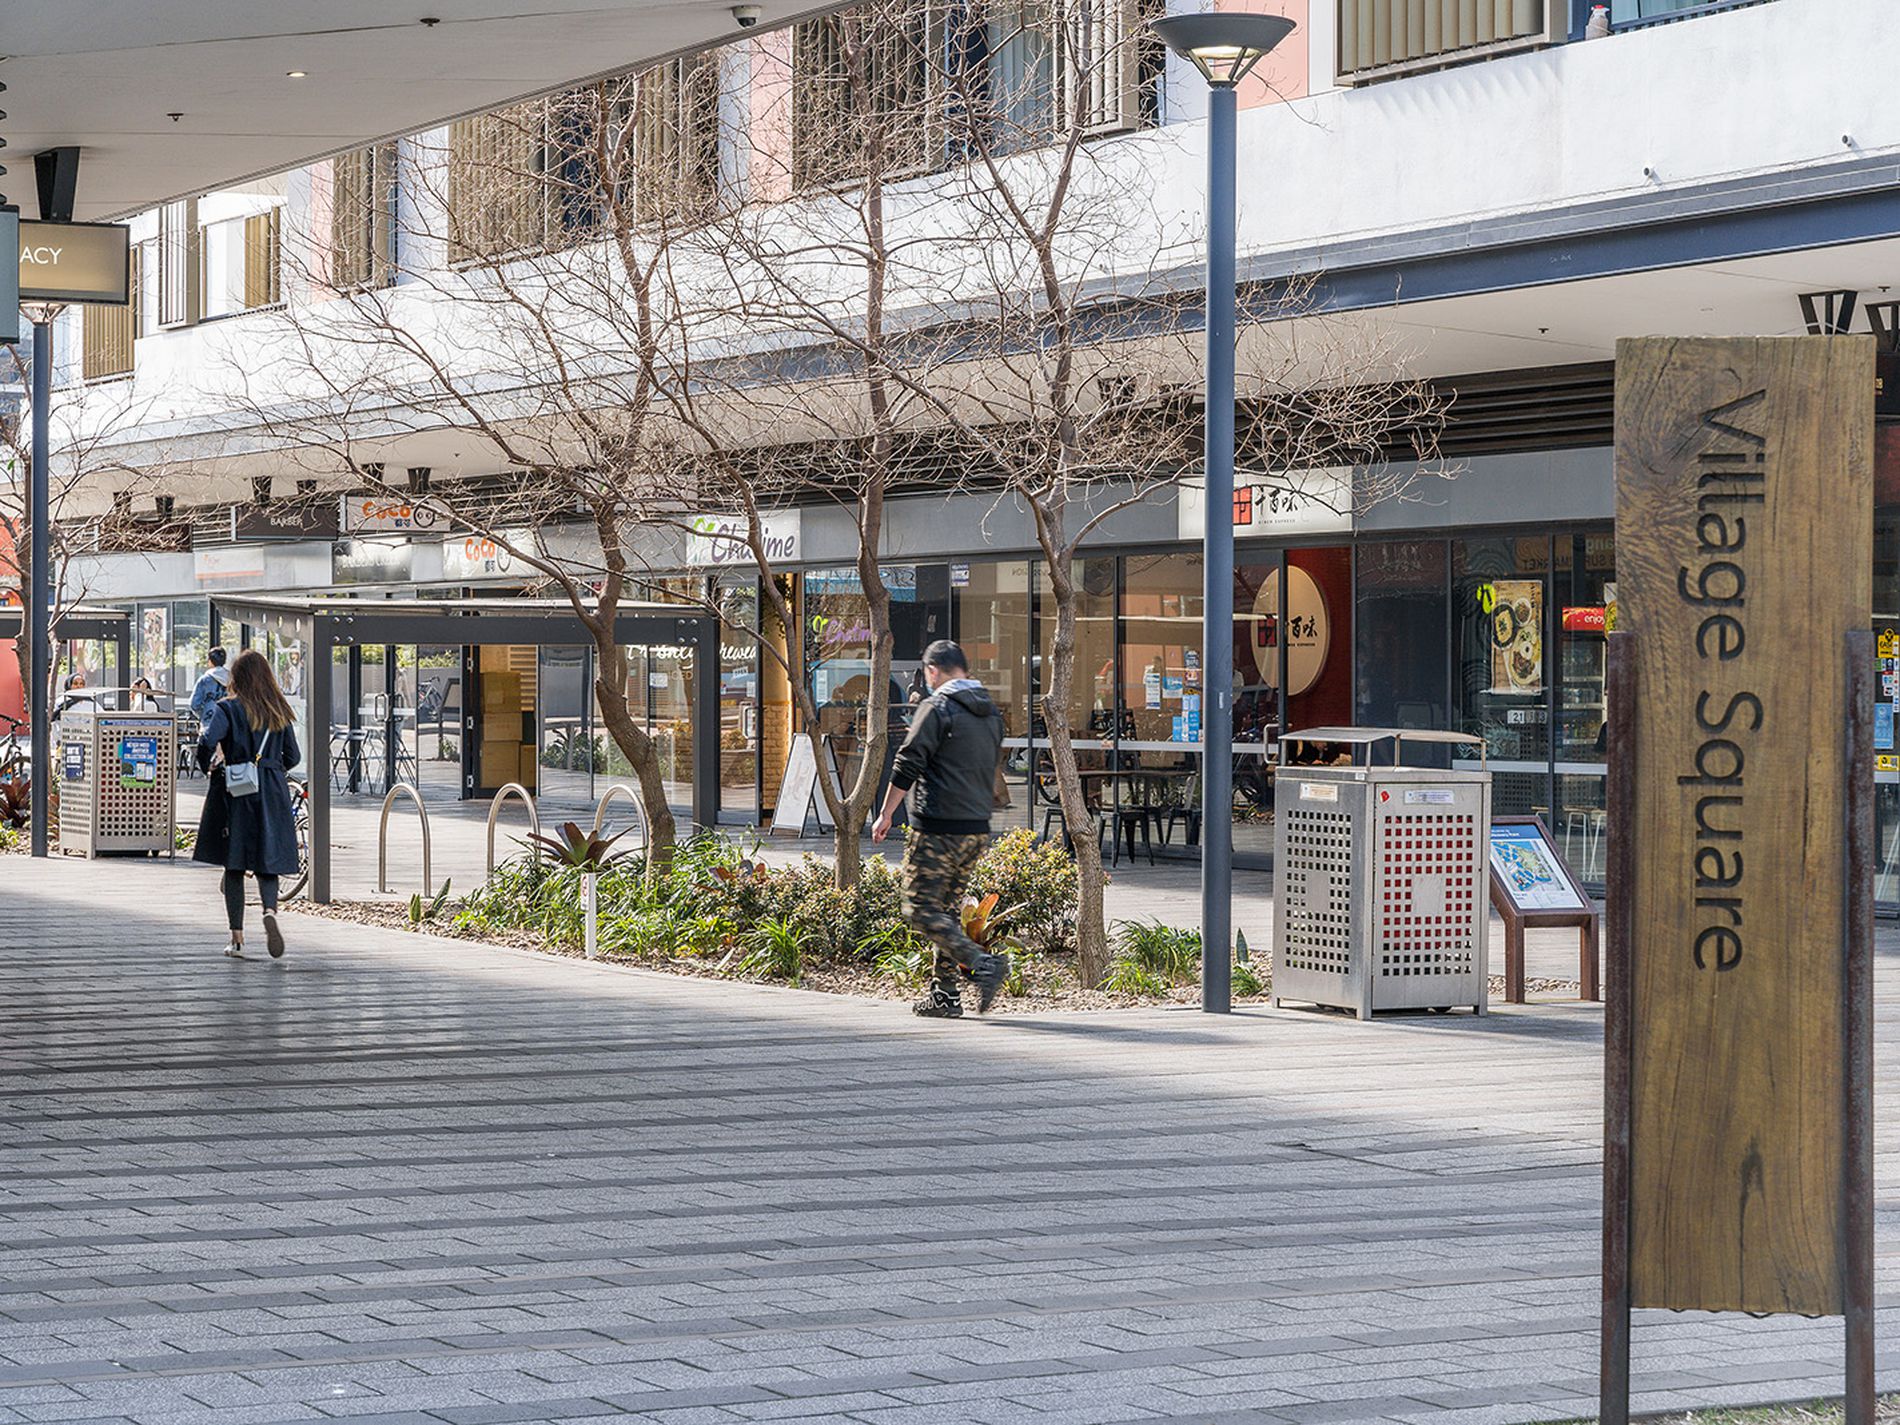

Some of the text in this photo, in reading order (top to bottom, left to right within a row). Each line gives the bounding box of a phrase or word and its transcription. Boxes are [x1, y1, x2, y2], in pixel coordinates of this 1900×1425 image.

[711, 523, 795, 563] Chaime
[825, 617, 872, 645] Chatim
[1287, 615, 1318, 638] 百味
[1677, 389, 1766, 972] Village Square
